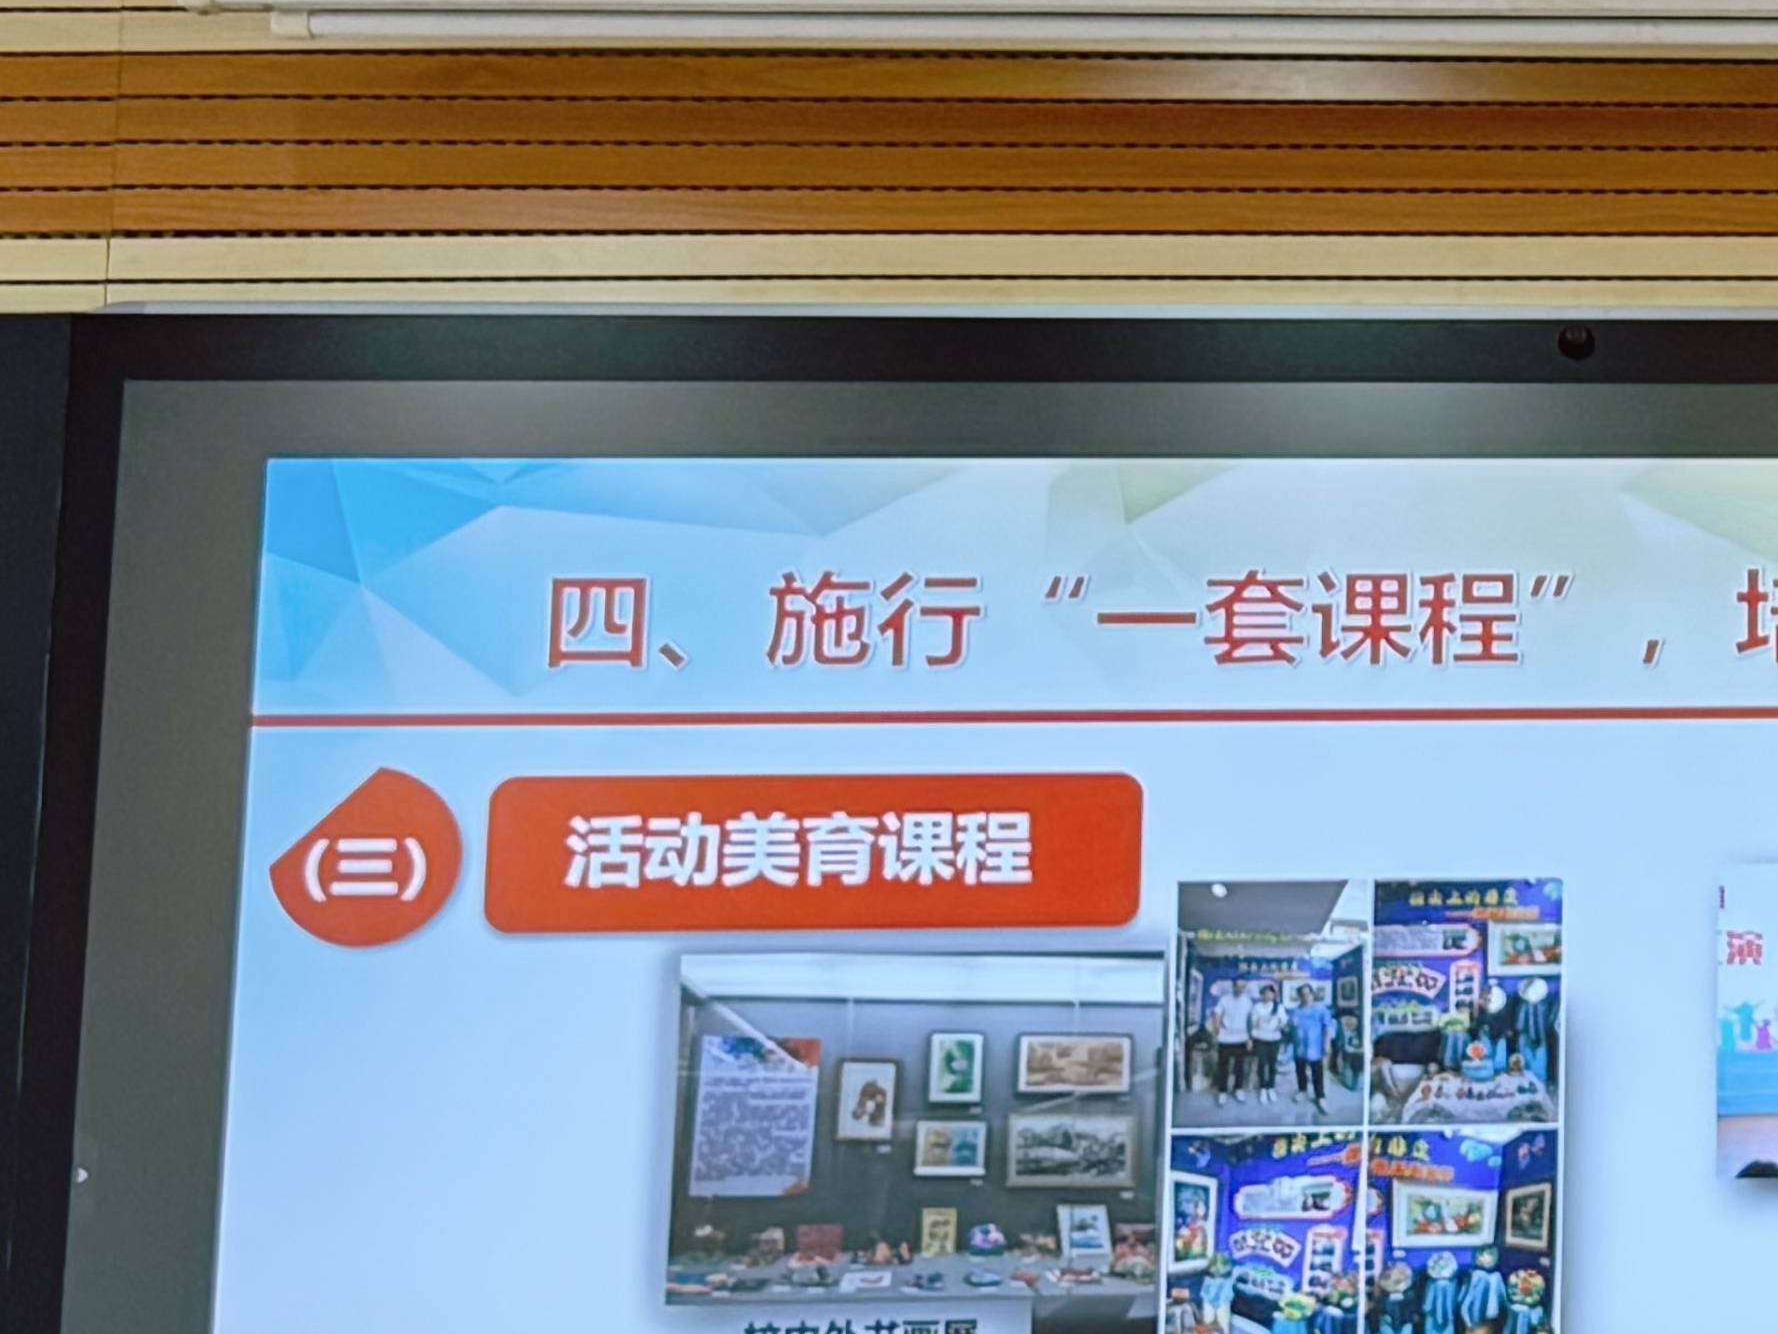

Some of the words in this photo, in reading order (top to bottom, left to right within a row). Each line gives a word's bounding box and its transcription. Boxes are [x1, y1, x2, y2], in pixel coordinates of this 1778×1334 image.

[304, 836, 427, 903] （三）
[565, 812, 1033, 889] 活动美育课程
